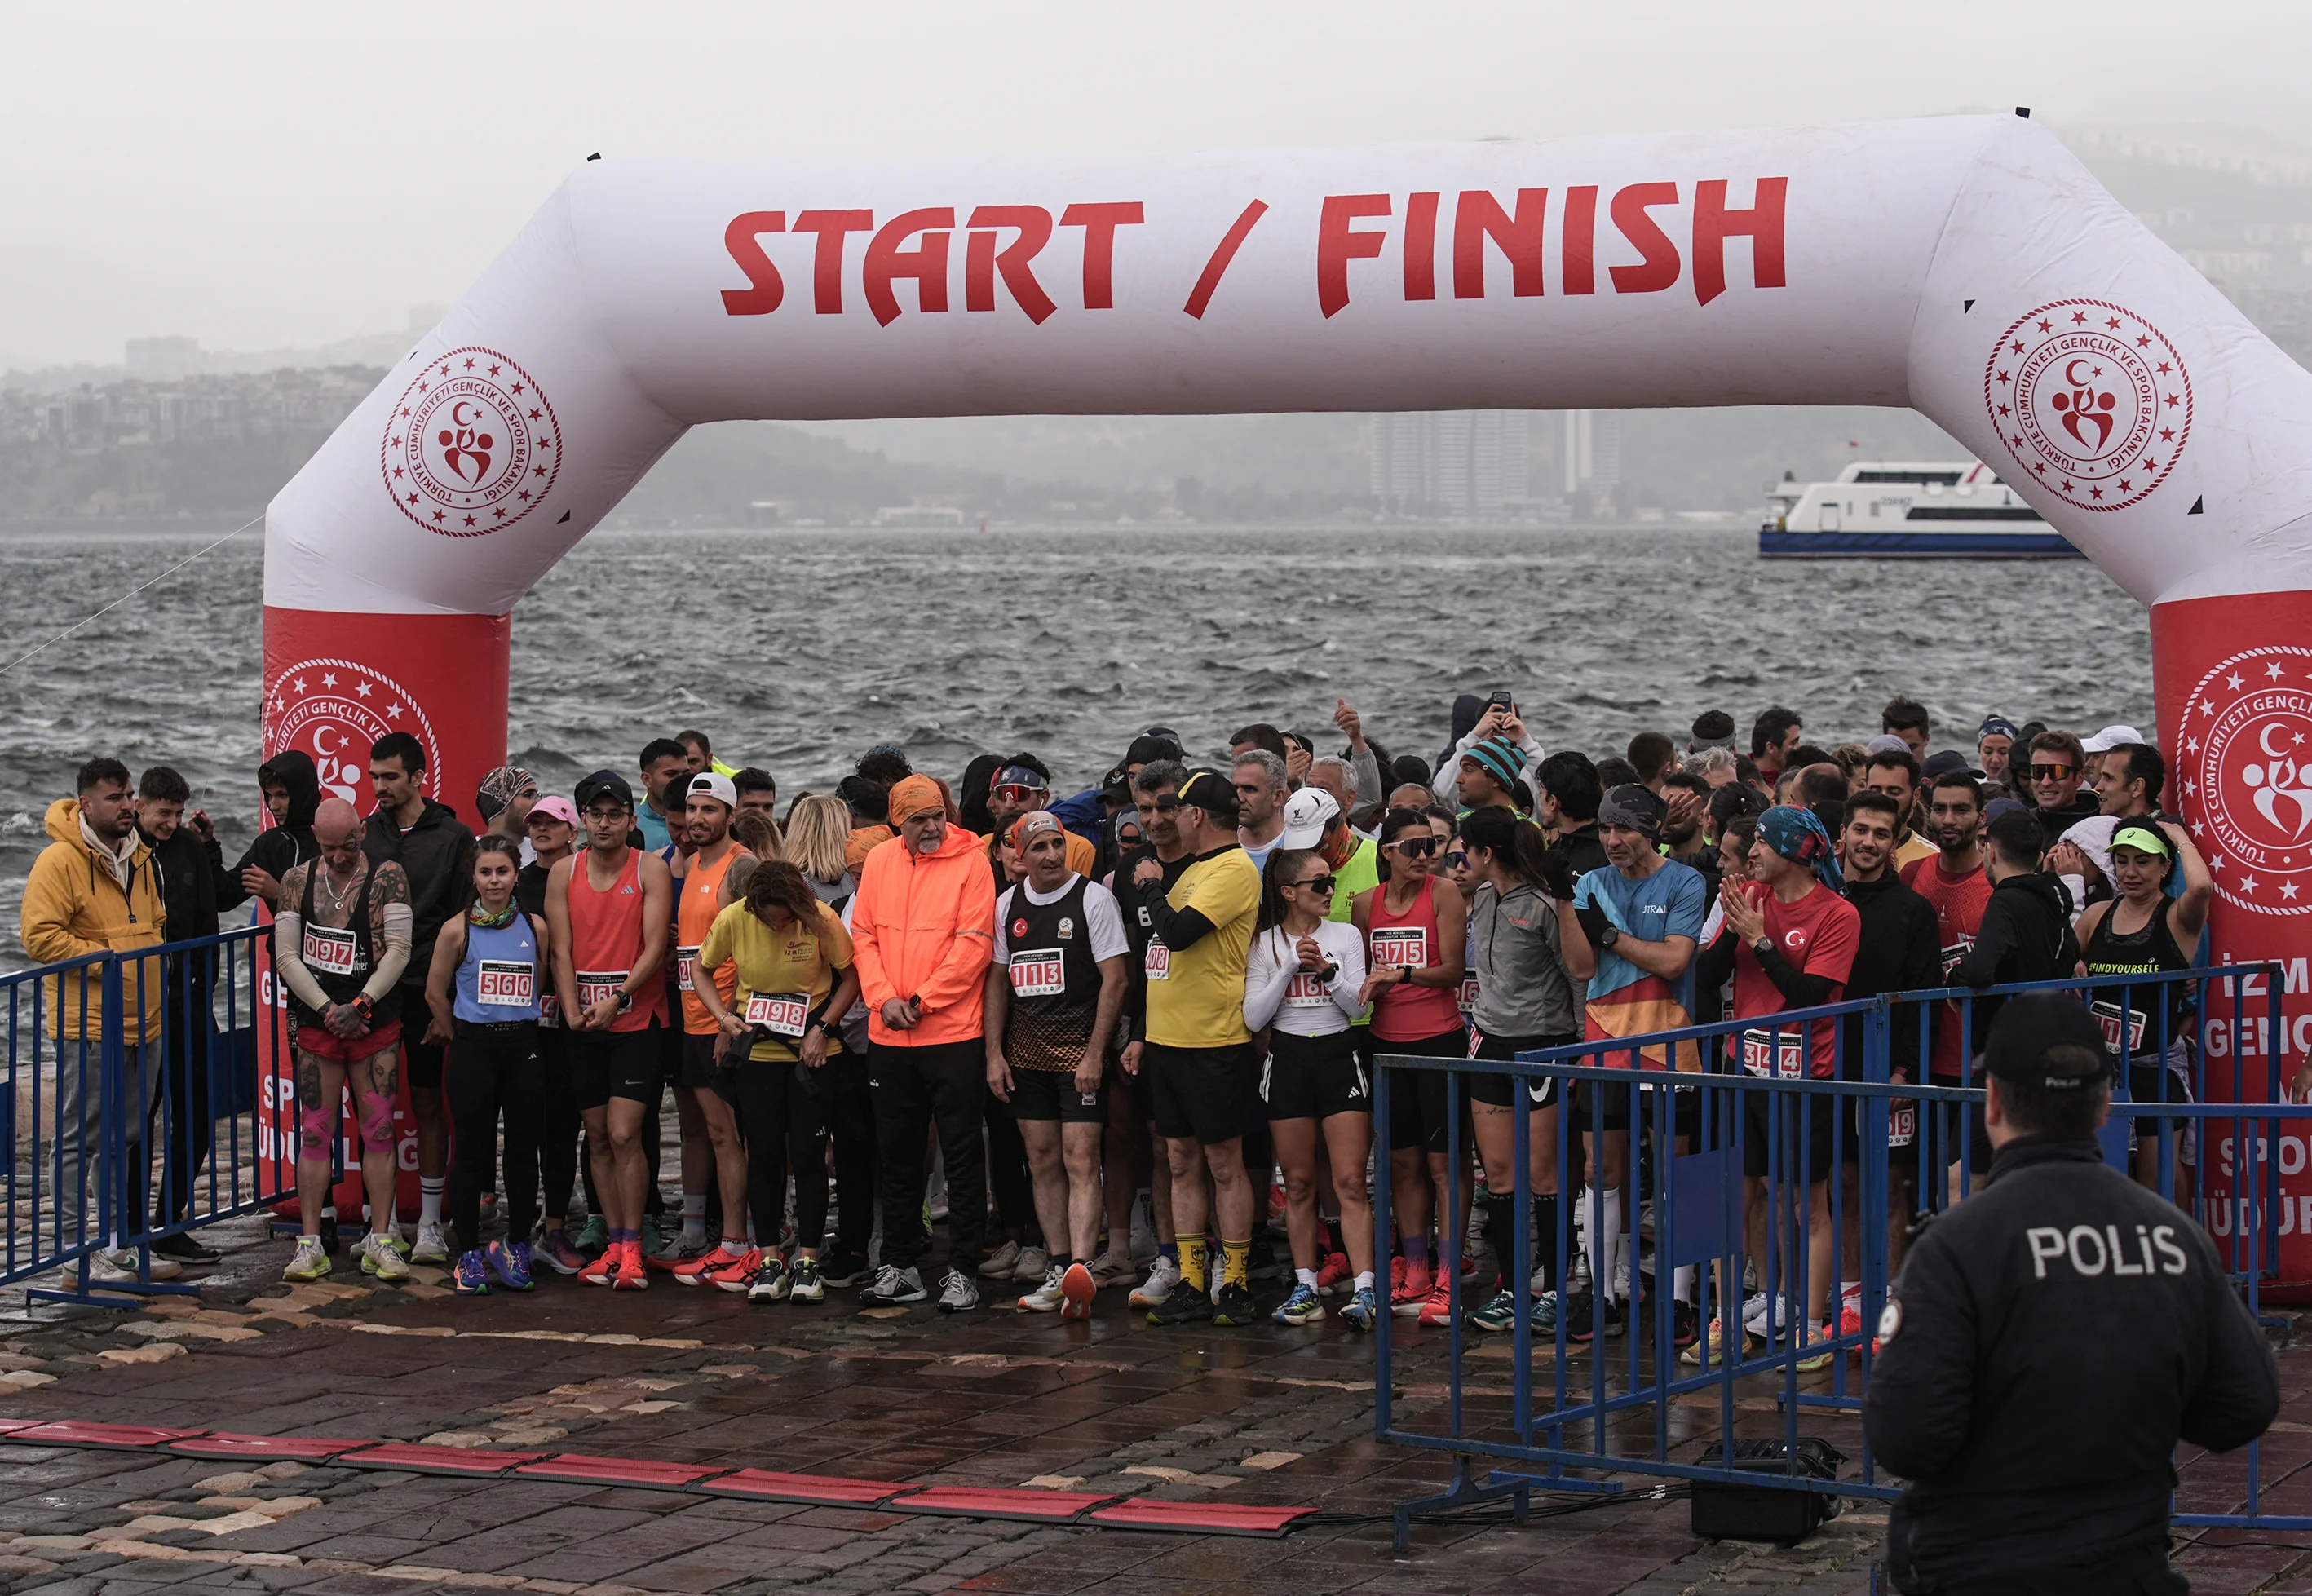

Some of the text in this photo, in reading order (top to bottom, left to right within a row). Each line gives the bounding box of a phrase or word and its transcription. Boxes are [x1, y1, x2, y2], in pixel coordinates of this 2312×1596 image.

[720, 176, 1788, 328] START / FINISH
[2020, 337, 2151, 471] TÜRKİYE CUMHURİYETİ GENÇLİK VE SPOR BAKANLIĞI
[410, 382, 525, 502] TÜRKİYE CUMHURİYETİ GENÇLİK VE SPOR BAKANLIĞI
[311, 702, 369, 726] GENÇLİK
[2206, 695, 2312, 864] TÜRKİYE CUMHURİYETİ GENÇLİ
[306, 938, 350, 962] 097
[1374, 943, 1421, 962] 575
[484, 975, 529, 995] 560
[1014, 964, 1059, 986] 113
[751, 1001, 802, 1024] 498
[2220, 1135, 2312, 1177] SPO
